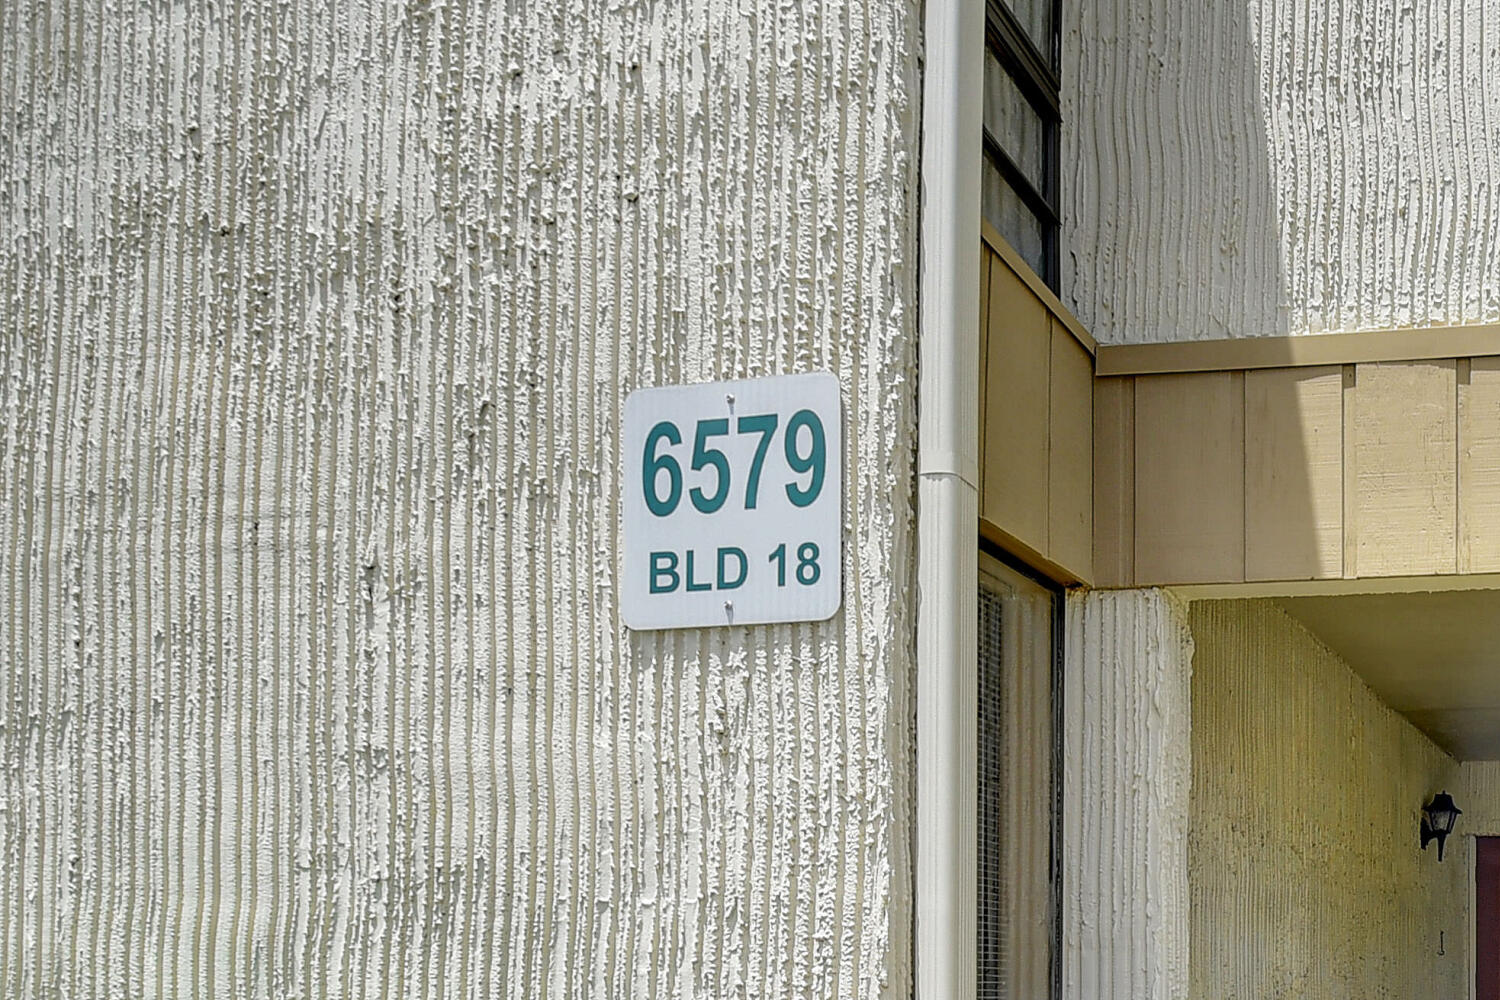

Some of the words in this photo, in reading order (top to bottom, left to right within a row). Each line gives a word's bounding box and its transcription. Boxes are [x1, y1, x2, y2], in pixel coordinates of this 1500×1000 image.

[642, 409, 827, 517] 6579
[649, 546, 748, 594] BLD
[768, 542, 821, 587] 18
